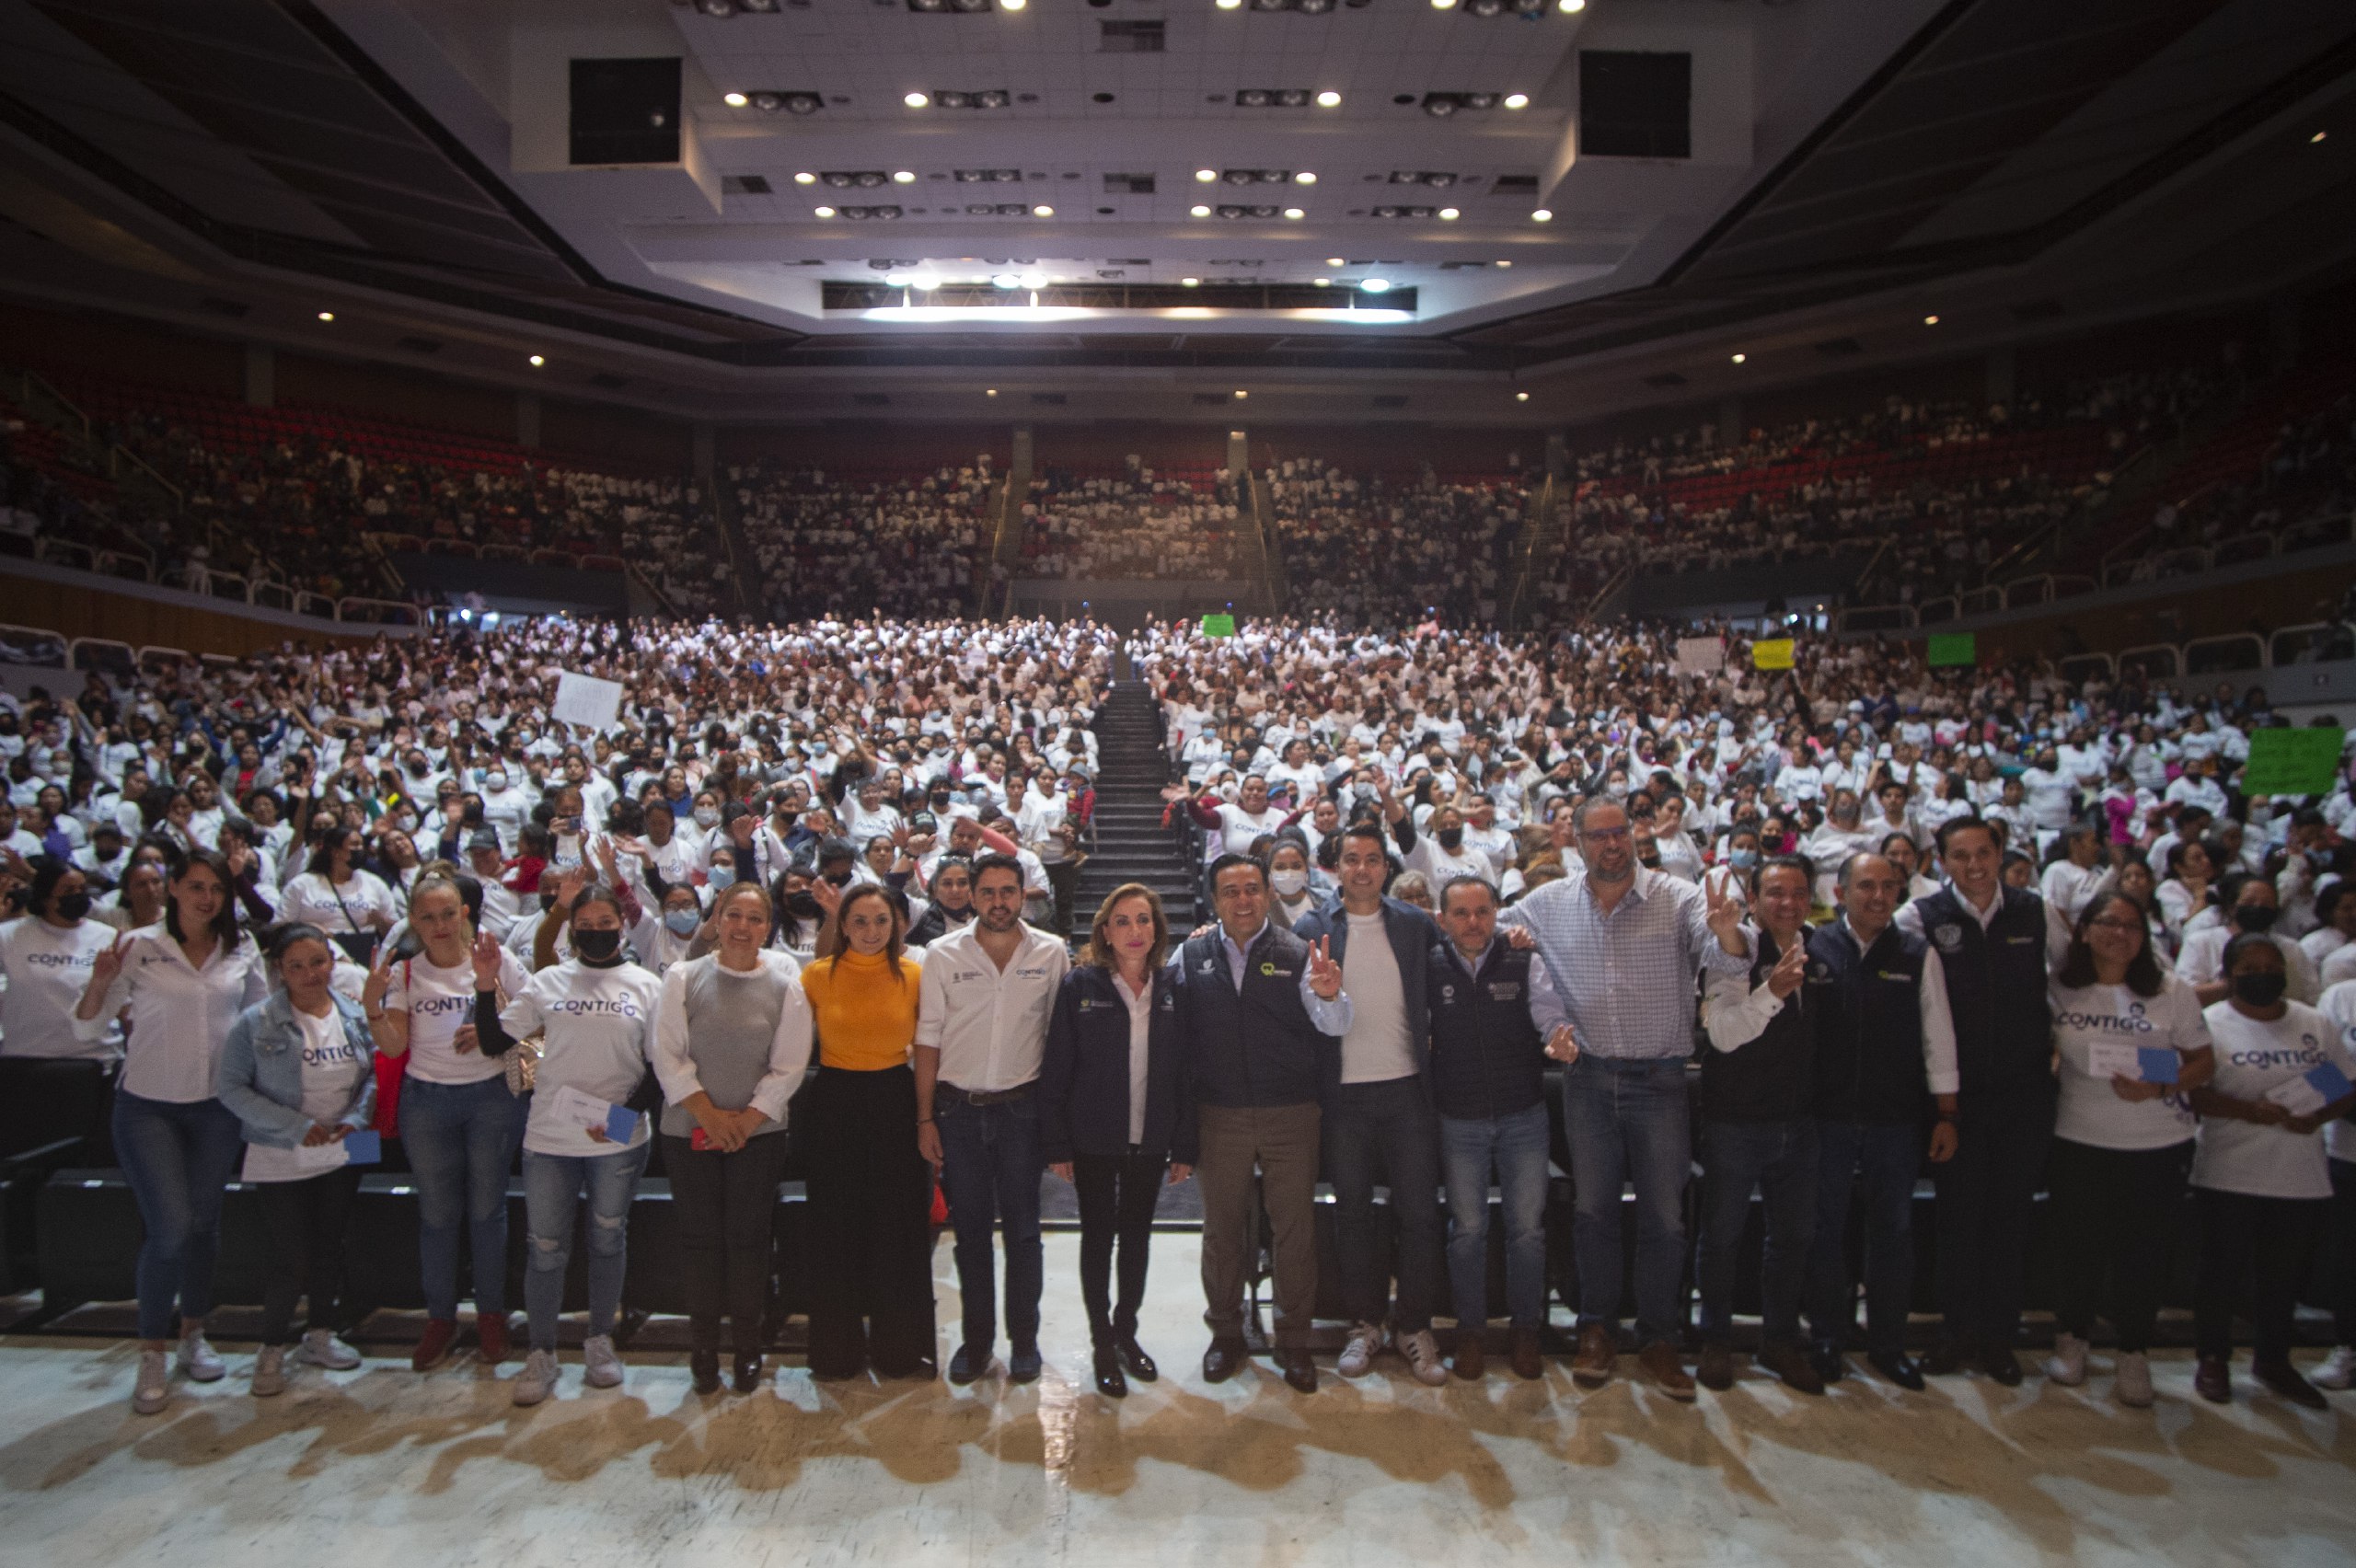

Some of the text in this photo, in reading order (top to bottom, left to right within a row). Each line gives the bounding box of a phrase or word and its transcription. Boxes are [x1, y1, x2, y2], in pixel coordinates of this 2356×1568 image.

[27, 953, 97, 968] CONTIG
[553, 999, 636, 1018] CONTIGO
[2058, 1011, 2152, 1032] CONTIGO
